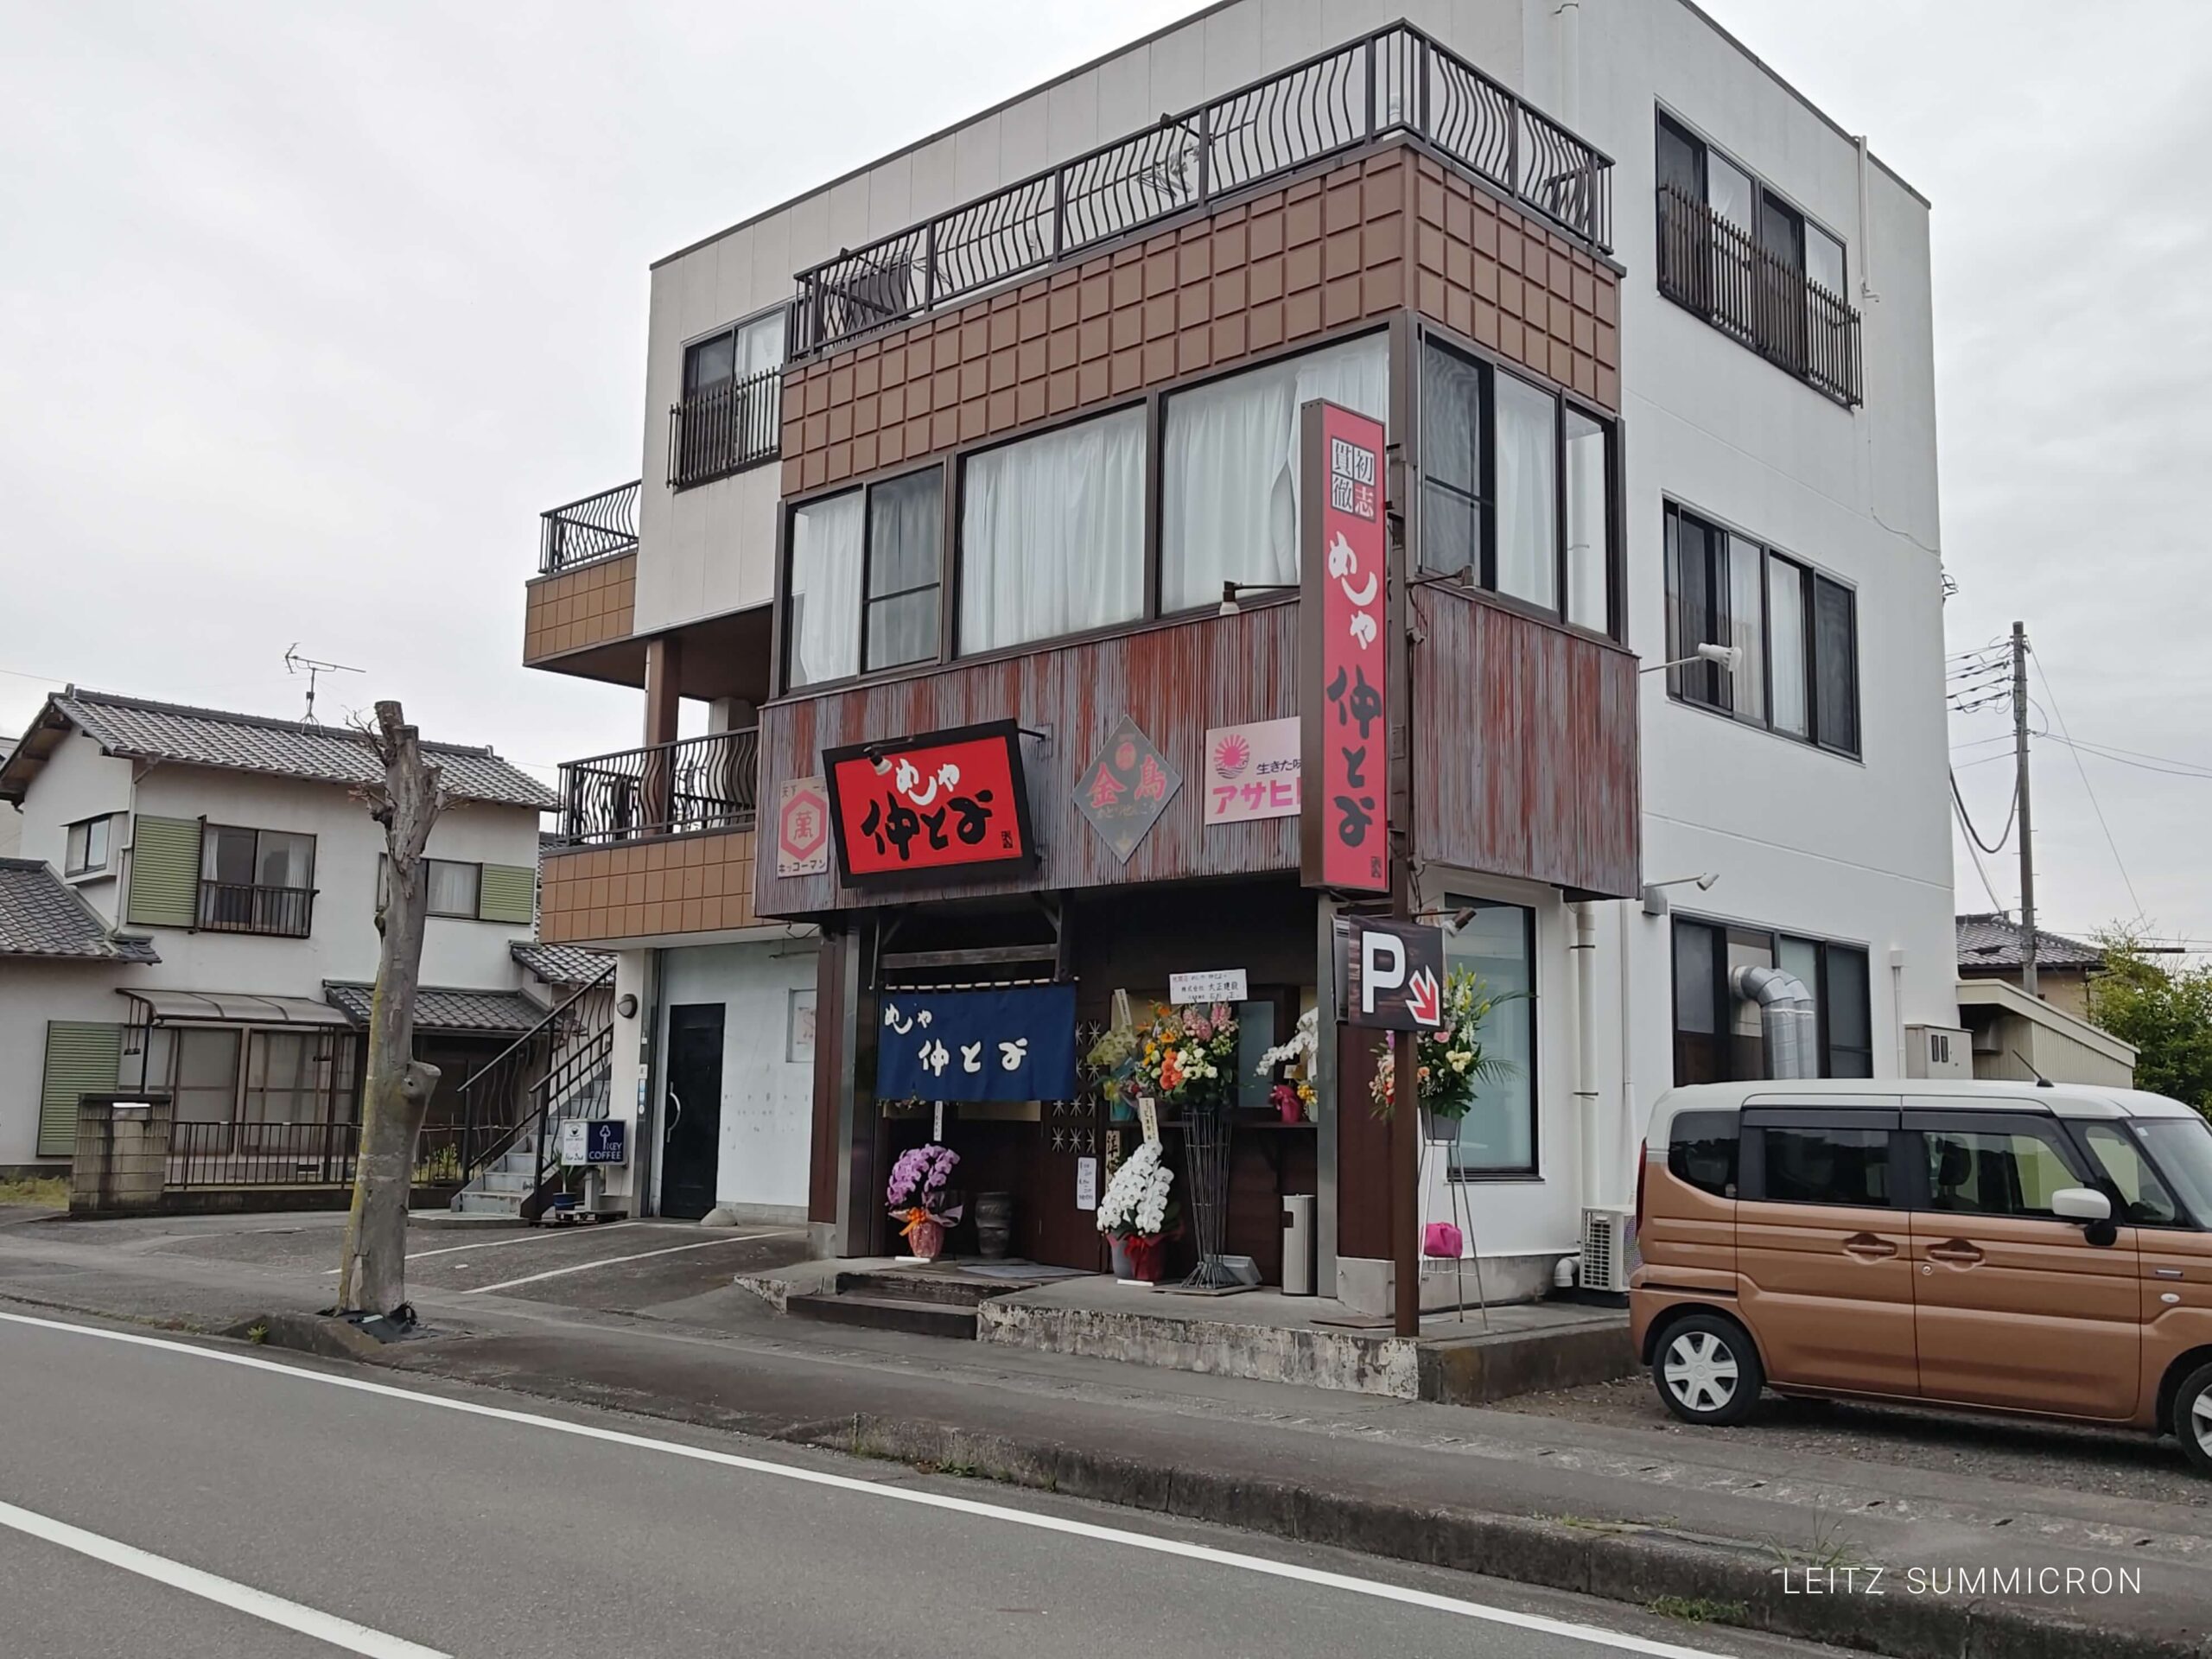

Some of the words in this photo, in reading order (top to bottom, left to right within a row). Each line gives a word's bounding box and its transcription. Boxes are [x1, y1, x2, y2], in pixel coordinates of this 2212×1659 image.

[1354, 449, 1375, 518] 初志
[1328, 530, 1378, 649] めしや
[896, 758, 960, 805] めしや
[1089, 753, 1166, 809] 金鳥
[1212, 777, 1301, 815] アサヒ
[779, 859, 826, 873] キッコーマン
[1363, 931, 1406, 1014] P
[885, 1003, 932, 1034] めしや
[588, 1151, 621, 1160] COFFEE
[607, 1142, 622, 1151] KEY
